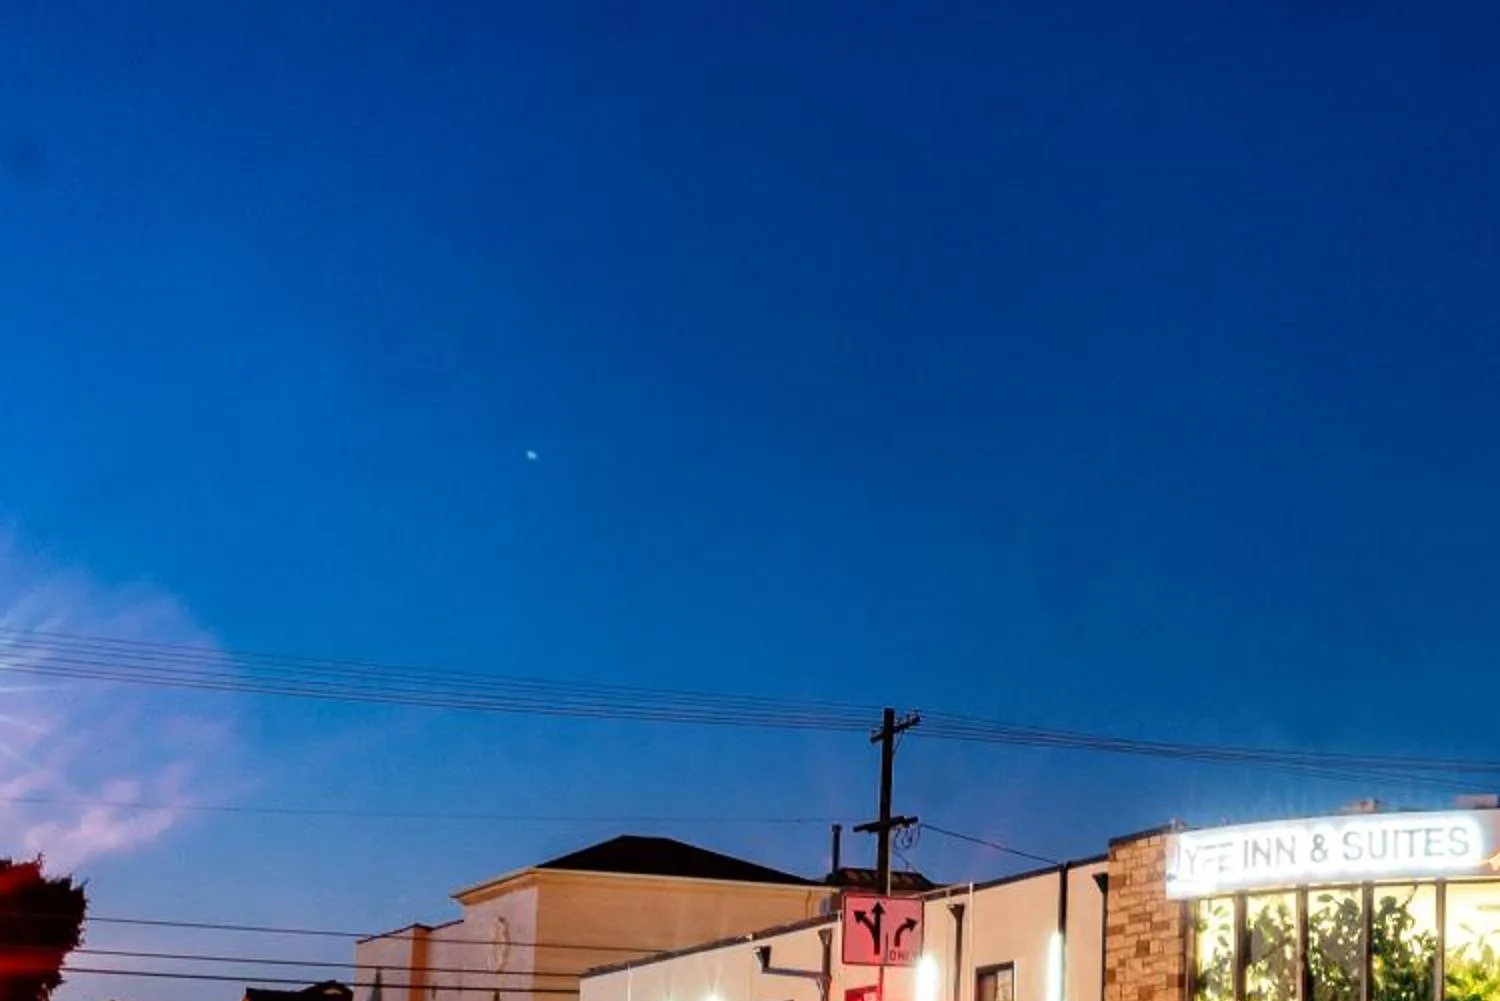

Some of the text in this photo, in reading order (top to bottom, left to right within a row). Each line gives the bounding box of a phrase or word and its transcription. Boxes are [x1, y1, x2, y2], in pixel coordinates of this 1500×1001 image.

[1243, 835, 1296, 869] INN
[1309, 833, 1329, 863] &
[1342, 826, 1470, 861] SUITES
